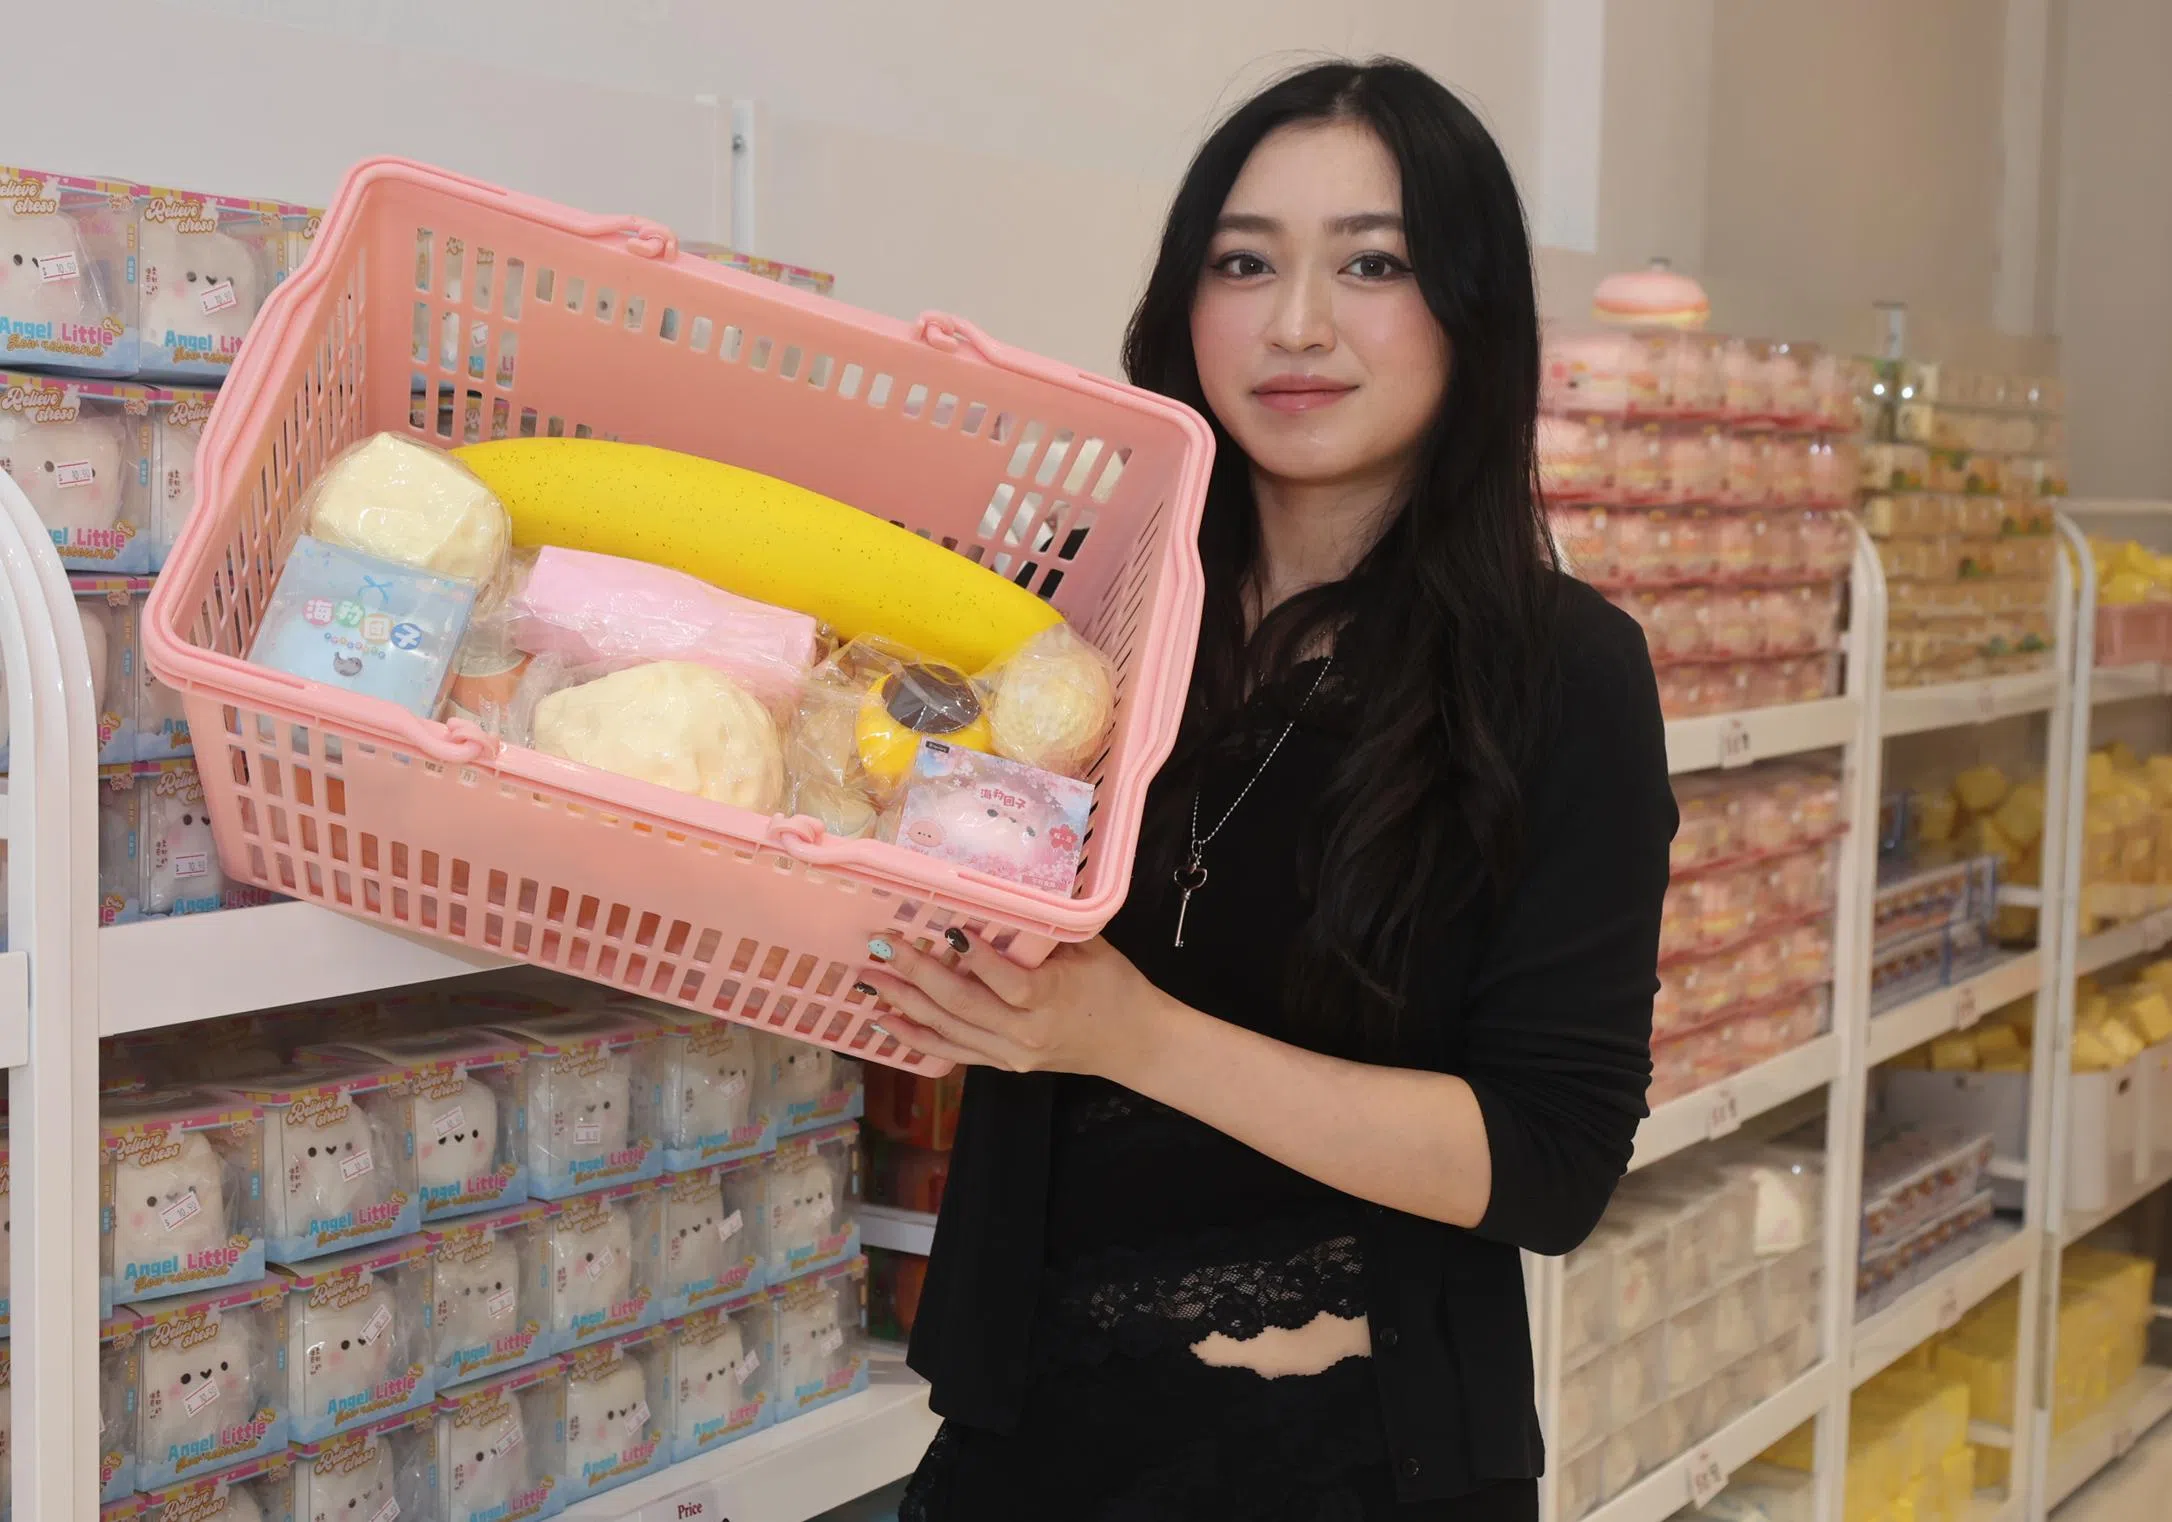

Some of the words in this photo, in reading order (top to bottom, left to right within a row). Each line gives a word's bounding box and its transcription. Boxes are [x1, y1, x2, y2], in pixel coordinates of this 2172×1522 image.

[0, 180, 38, 200] elieve
[14, 198, 56, 215] stress
[145, 199, 200, 222] Relieve
[177, 218, 216, 234] stress
[0, 316, 52, 339] Angel
[61, 323, 113, 345] Little
[164, 331, 212, 351] Angel
[220, 335, 243, 352] Lit
[1, 386, 63, 411] Relieve
[35, 406, 76, 423] stress
[76, 527, 124, 548] Little
[139, 1143, 181, 1167] stress
[419, 1181, 461, 1202] Angel
[467, 1173, 507, 1193] Little
[309, 1212, 353, 1236] Angel
[359, 1201, 400, 1224] Little
[124, 1256, 179, 1281] Angel
[187, 1249, 239, 1271] Little
[151, 1313, 204, 1347] Relieve
[182, 1323, 217, 1348] stress
[452, 1343, 491, 1367] Angel
[496, 1333, 532, 1355] Little
[327, 1391, 370, 1414] Angel
[375, 1376, 417, 1400] Little
[168, 1435, 215, 1461] Angel
[220, 1421, 267, 1446] Little
[512, 1487, 549, 1511] Little
[678, 1502, 702, 1519] Price
